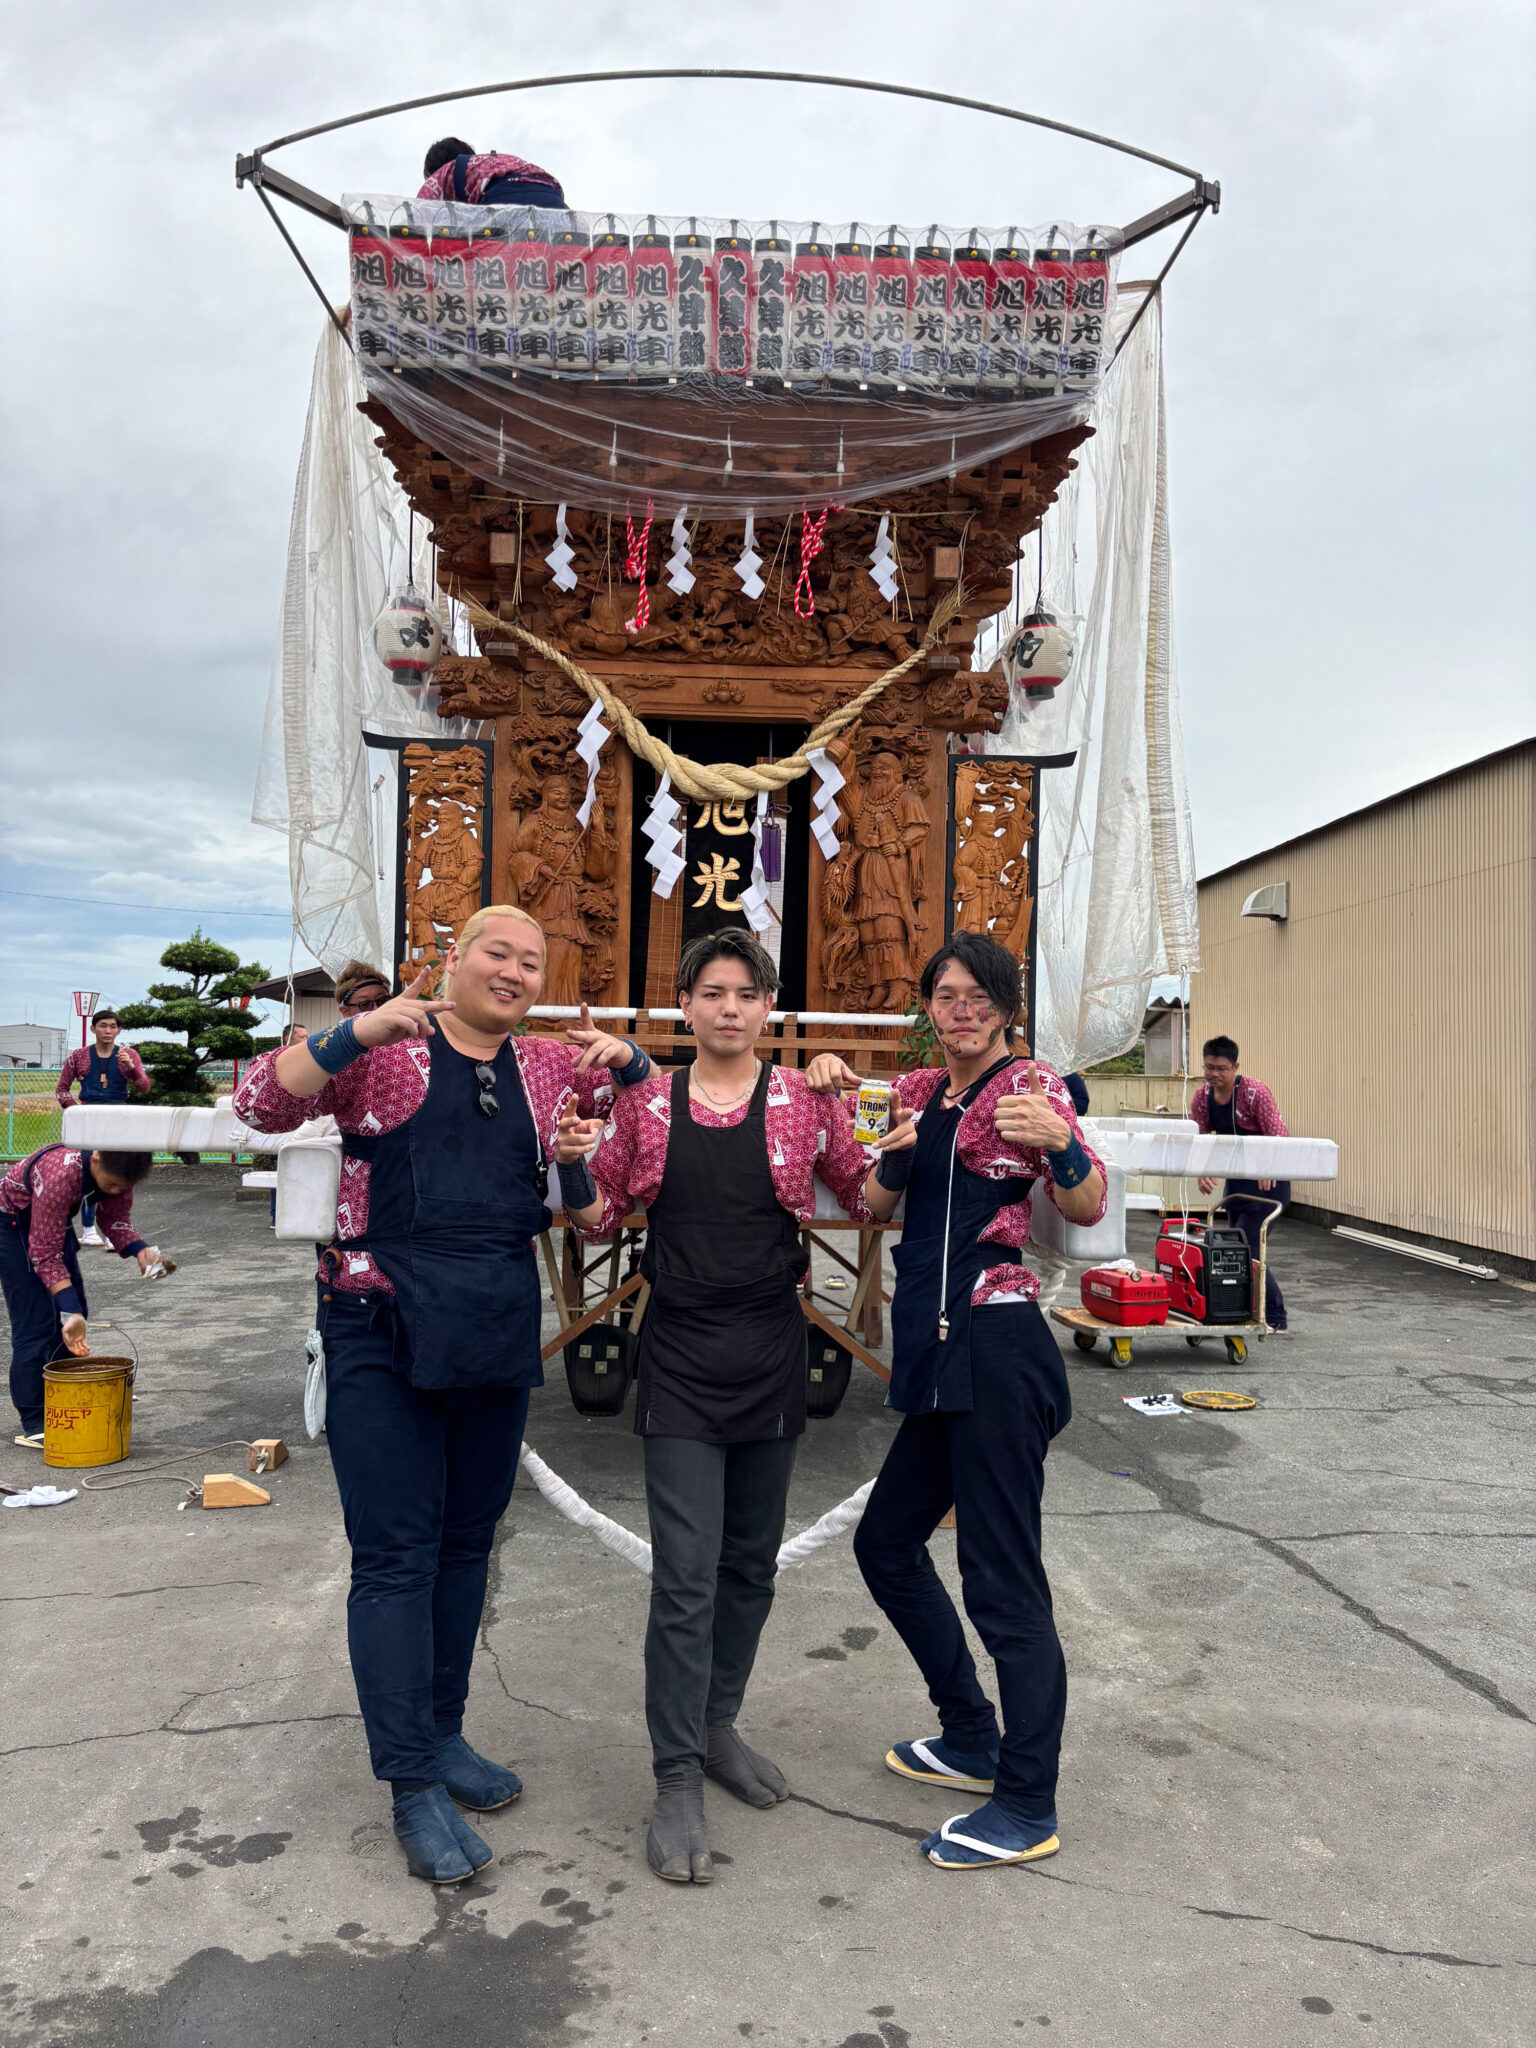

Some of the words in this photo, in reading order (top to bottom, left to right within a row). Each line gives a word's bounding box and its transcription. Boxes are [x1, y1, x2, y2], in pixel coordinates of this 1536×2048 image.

[474, 258, 508, 357] 旭光車
[515, 259, 551, 358] 旭光車
[555, 261, 588, 362] 旭光車
[595, 264, 628, 363] 旭光車
[634, 266, 668, 366] 旭光車
[1067, 279, 1104, 378] 旭光車
[859, 1100, 888, 1113] STRONG
[868, 1118, 876, 1130] 9
